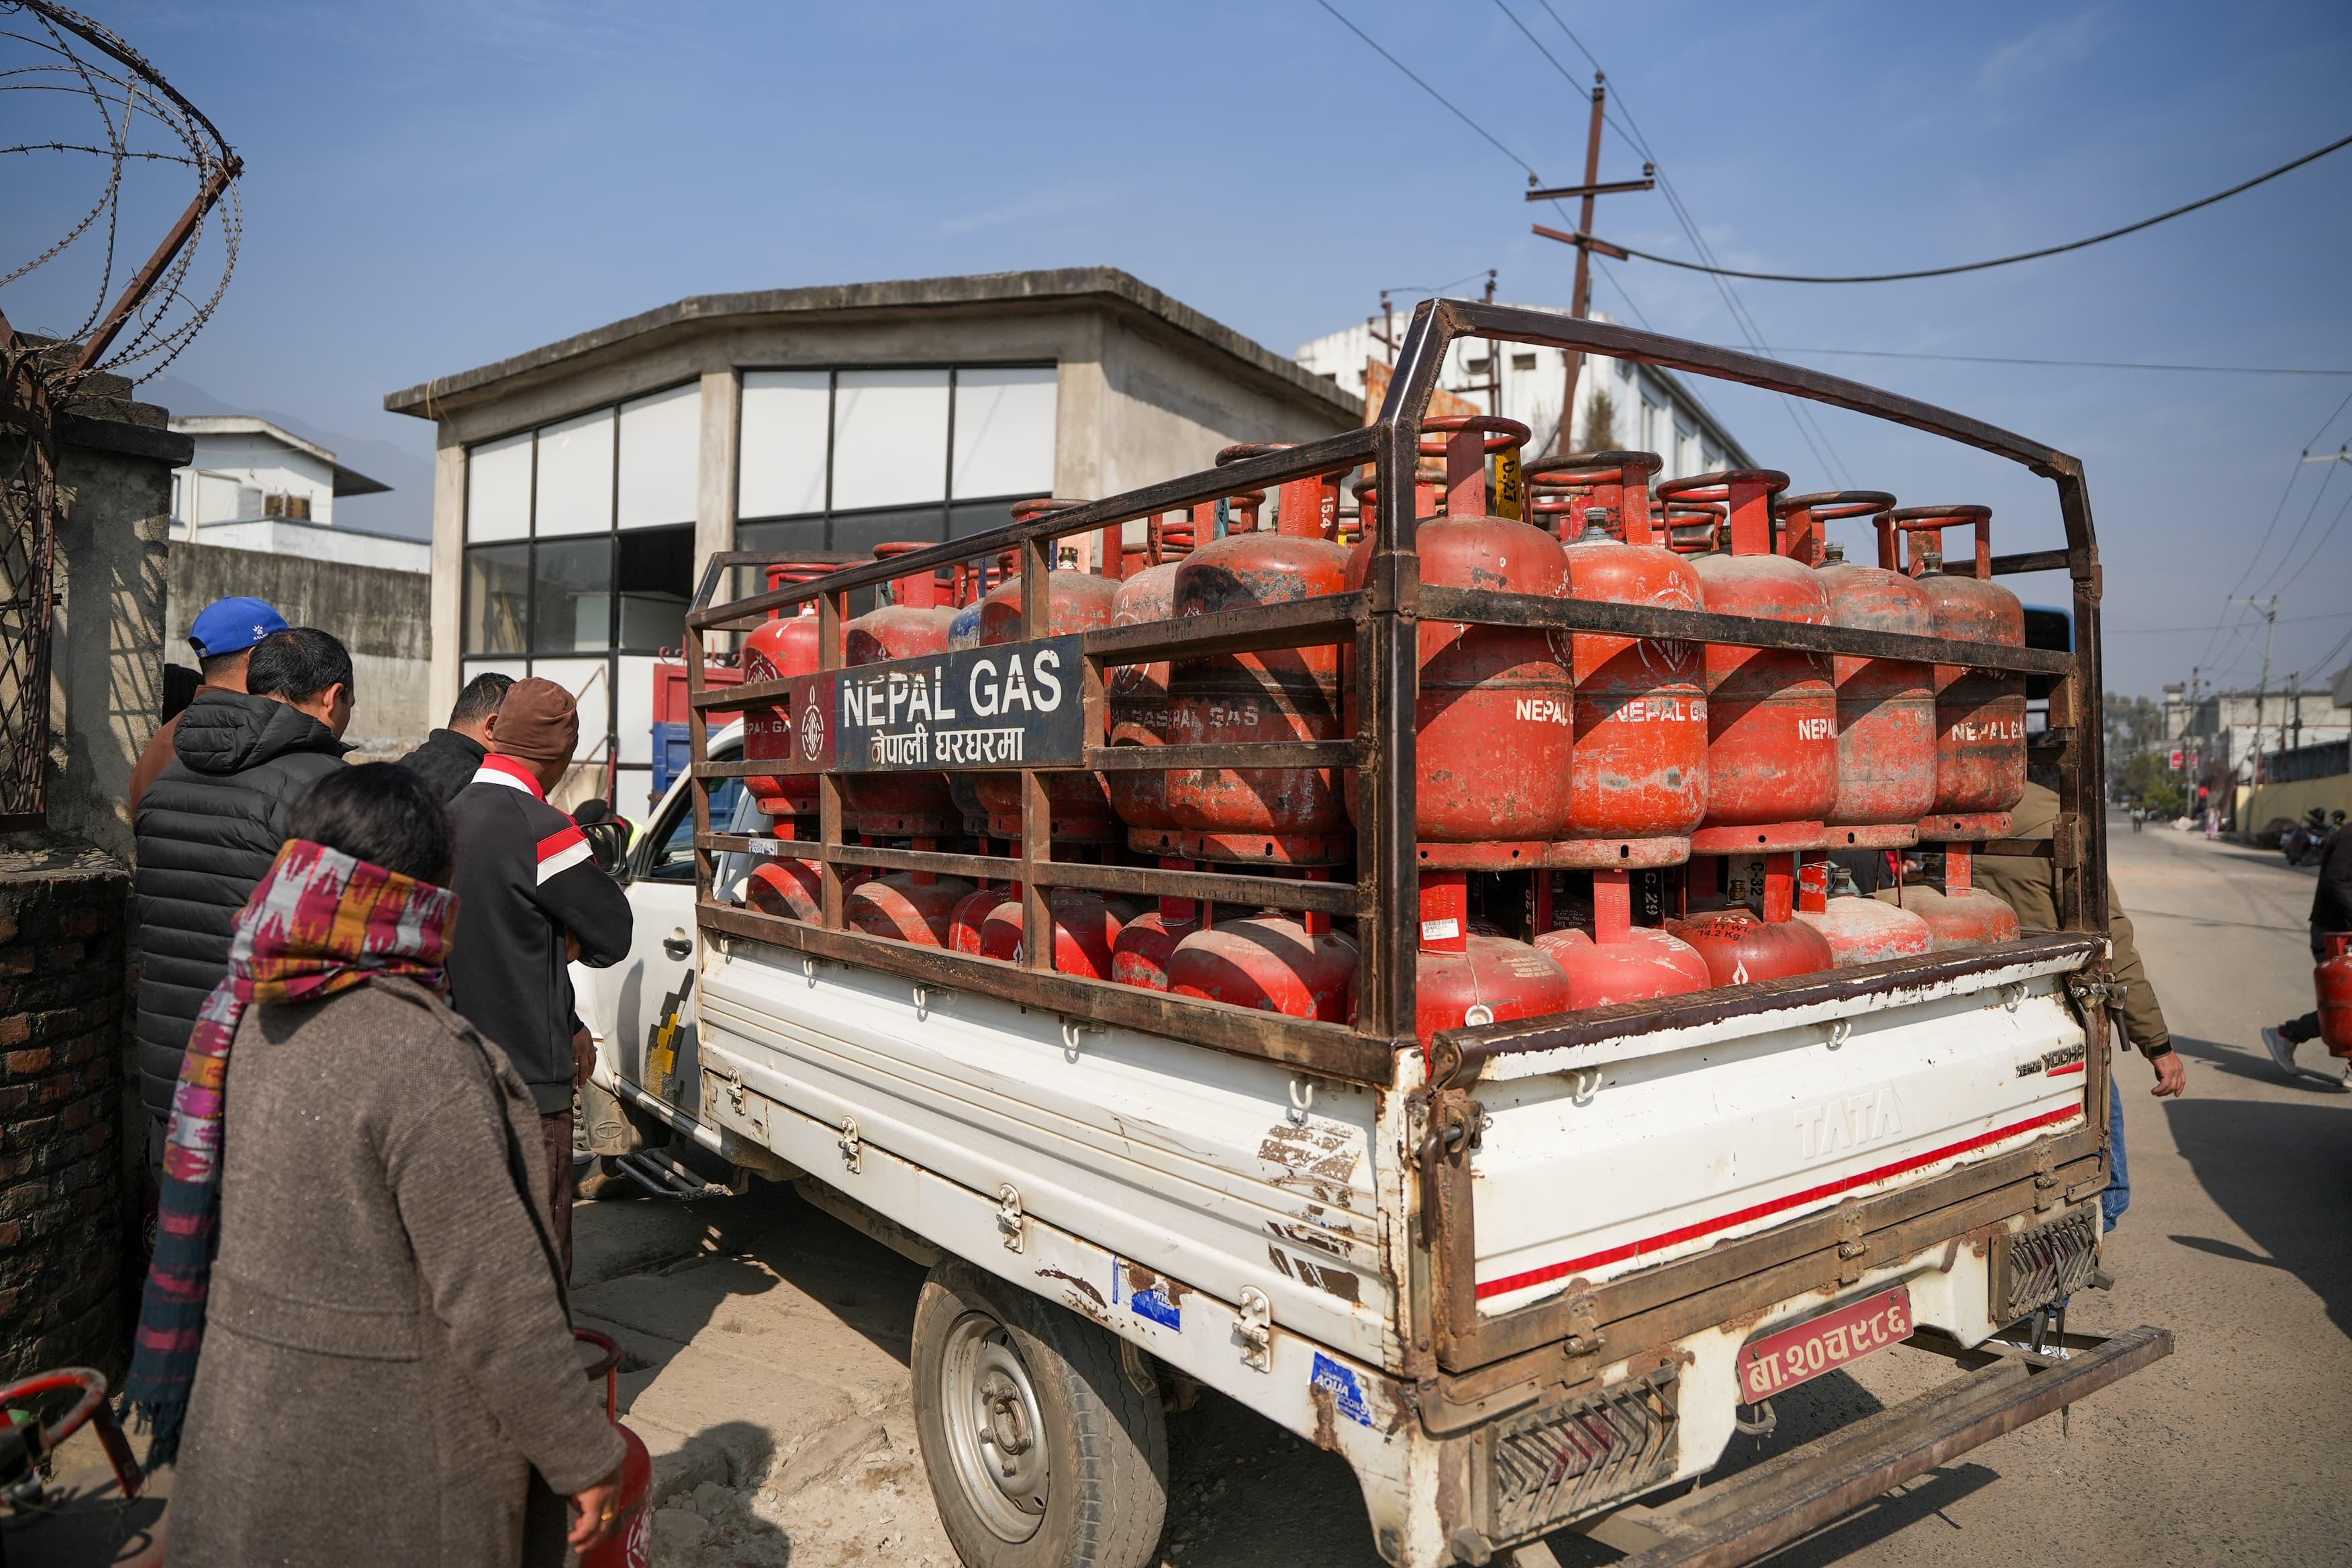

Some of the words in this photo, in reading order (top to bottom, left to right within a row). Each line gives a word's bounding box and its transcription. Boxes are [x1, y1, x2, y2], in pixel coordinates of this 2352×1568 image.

[1320, 497, 1334, 529] 15.4
[844, 665, 956, 728] NEPAL
[969, 649, 1062, 717] GAS
[1209, 705, 1259, 728] GAS
[1516, 699, 1567, 726] NEPAL
[1610, 701, 1686, 722] NEPAL
[871, 722, 929, 765] नेपाली
[935, 727, 1026, 764] घरघरमा
[1798, 718, 1838, 740] NEPAL
[1951, 722, 2008, 741] NEPAL
[1750, 862, 1764, 896] C-32
[2041, 1042, 2084, 1073] YODHA
[1794, 1087, 1902, 1160] TATA
